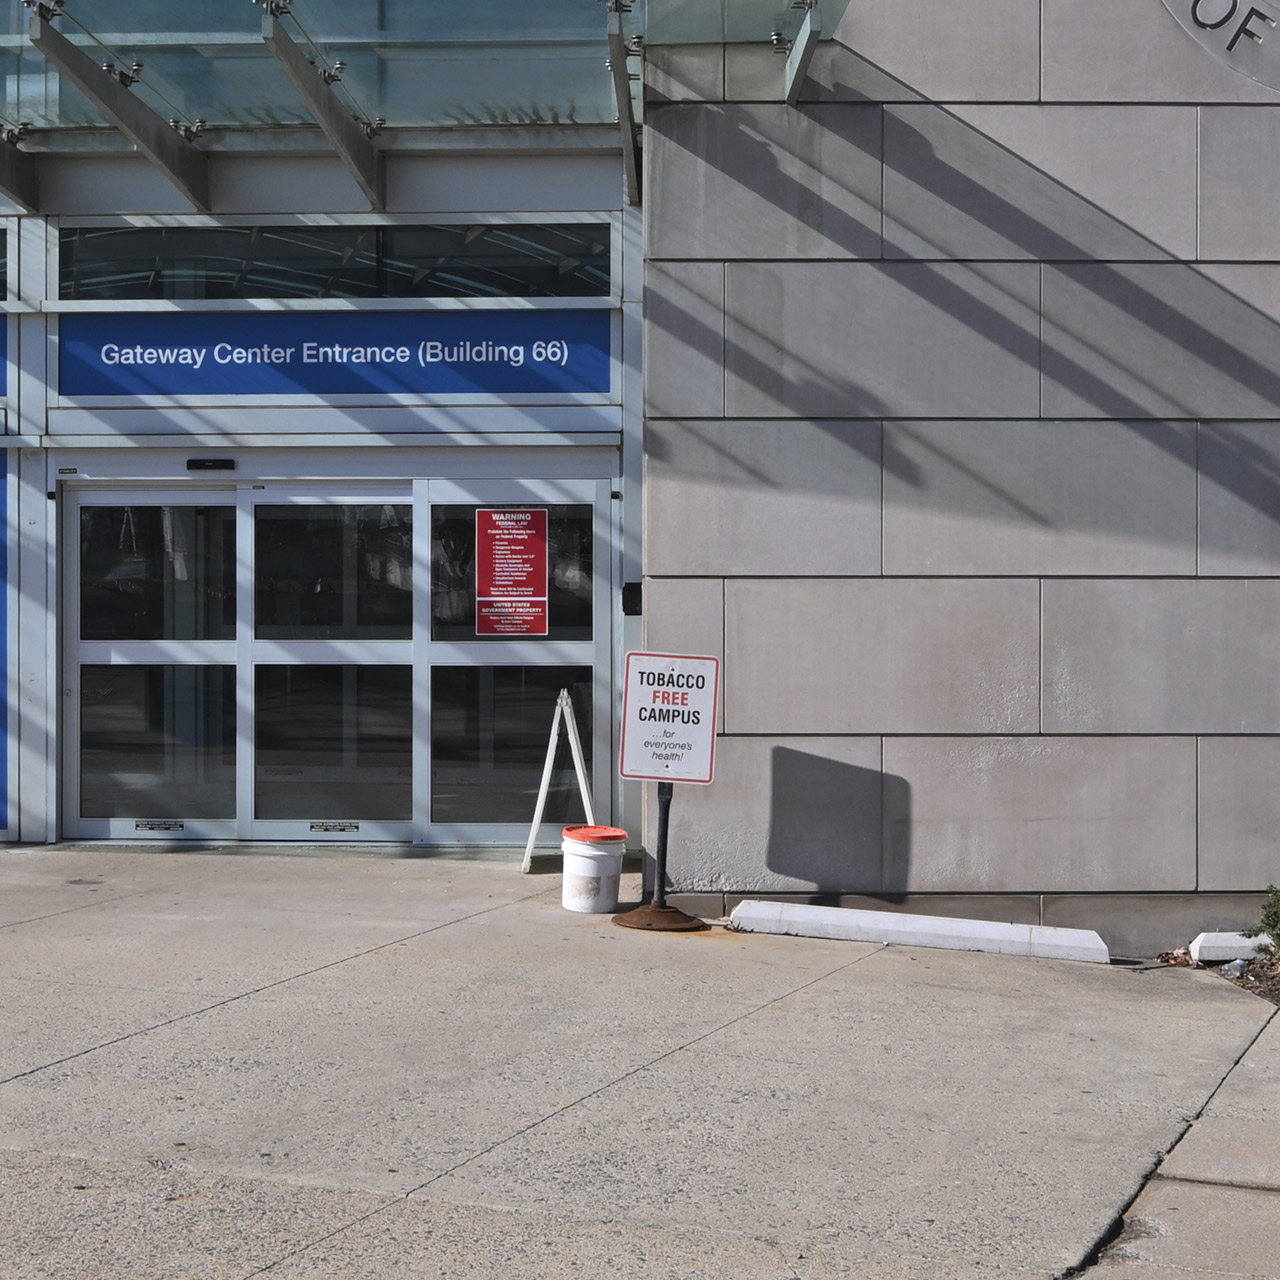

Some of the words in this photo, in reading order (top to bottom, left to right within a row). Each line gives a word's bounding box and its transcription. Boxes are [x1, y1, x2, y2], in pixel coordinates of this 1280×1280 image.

[101, 344, 206, 369] Gateway
[213, 343, 294, 364] Center
[302, 342, 410, 363] Entrance
[418, 341, 525, 367] (Building
[532, 340, 569, 366] 66)
[638, 671, 705, 689] TOBACCO
[652, 690, 689, 706] FREE
[639, 707, 701, 725] CAMPUS
[652, 730, 675, 738] ...for
[644, 741, 692, 751] everyone's
[652, 751, 684, 761] health!
